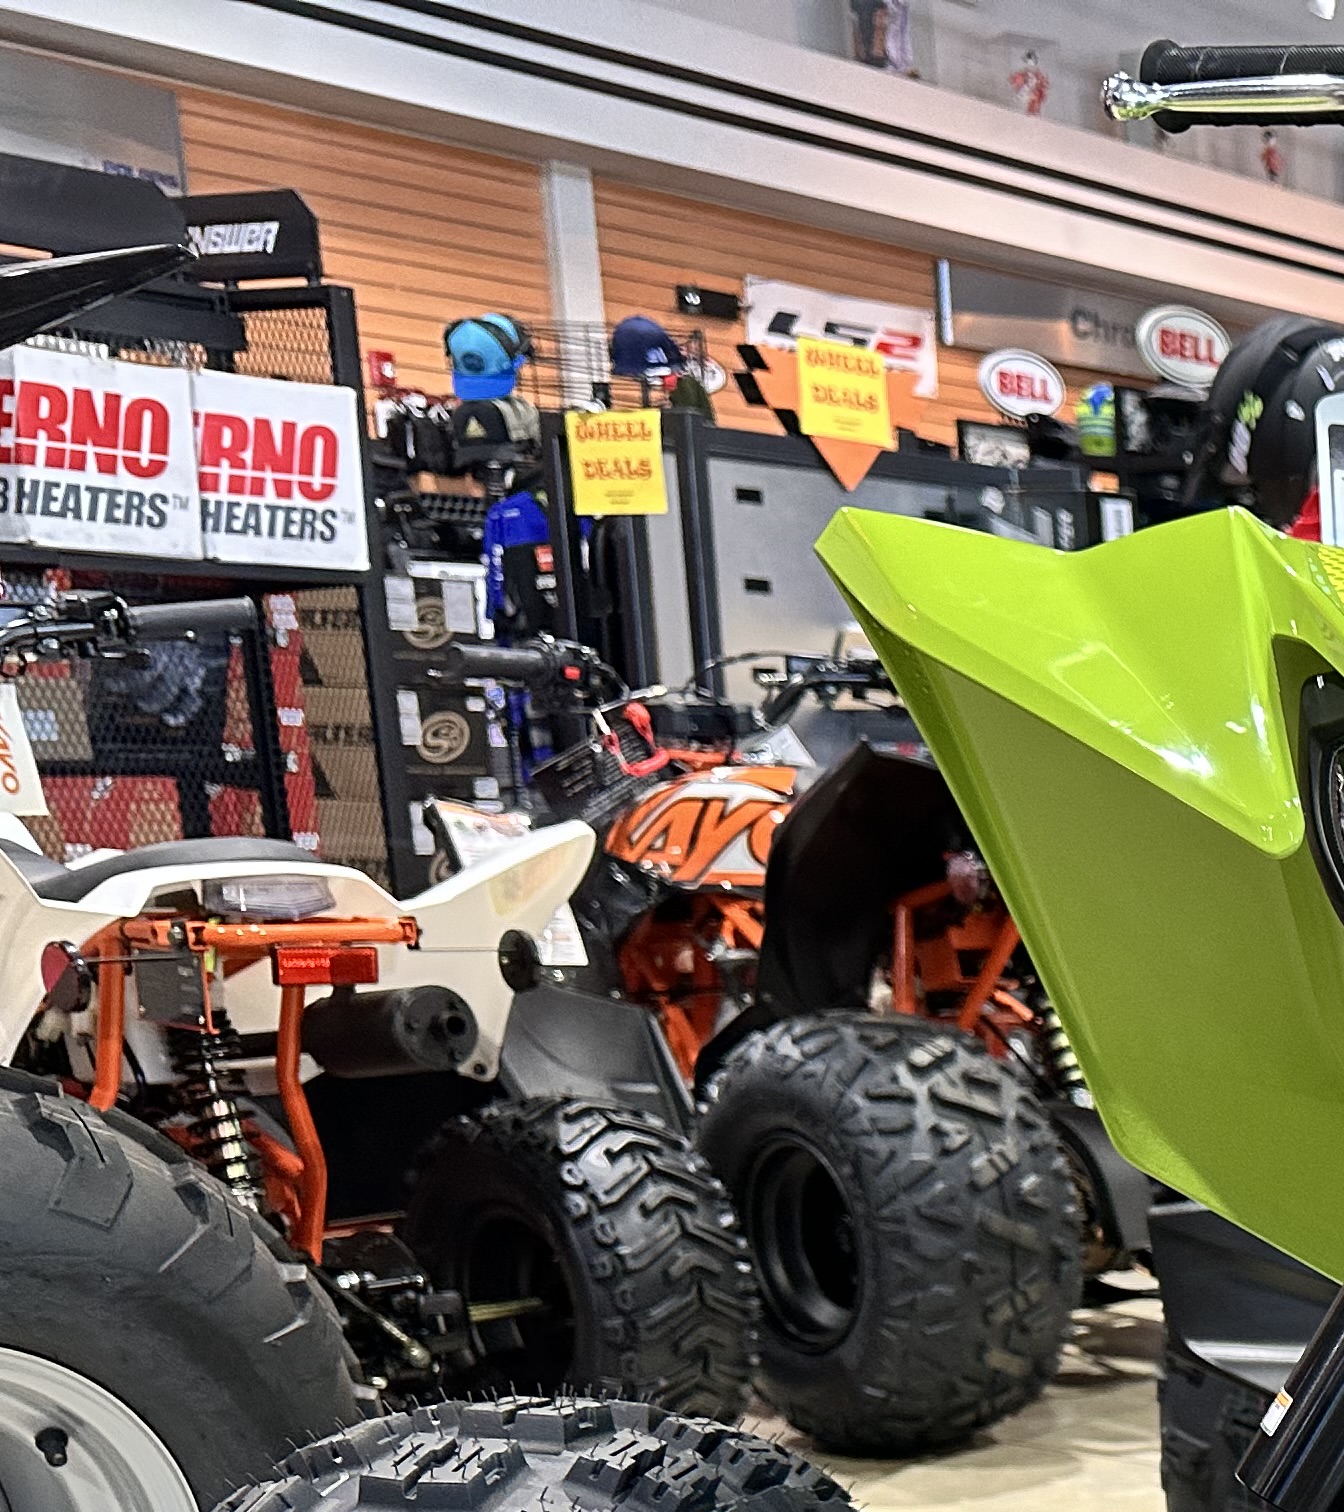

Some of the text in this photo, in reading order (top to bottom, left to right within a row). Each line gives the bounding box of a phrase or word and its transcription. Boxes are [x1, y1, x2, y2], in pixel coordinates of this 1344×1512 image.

[1158, 326, 1221, 366] BELL
[806, 347, 880, 376] WHEEL
[812, 383, 879, 414] DEALS
[997, 370, 1050, 403] BELL
[575, 420, 653, 443] WHEEL
[582, 457, 652, 481] DEALS
